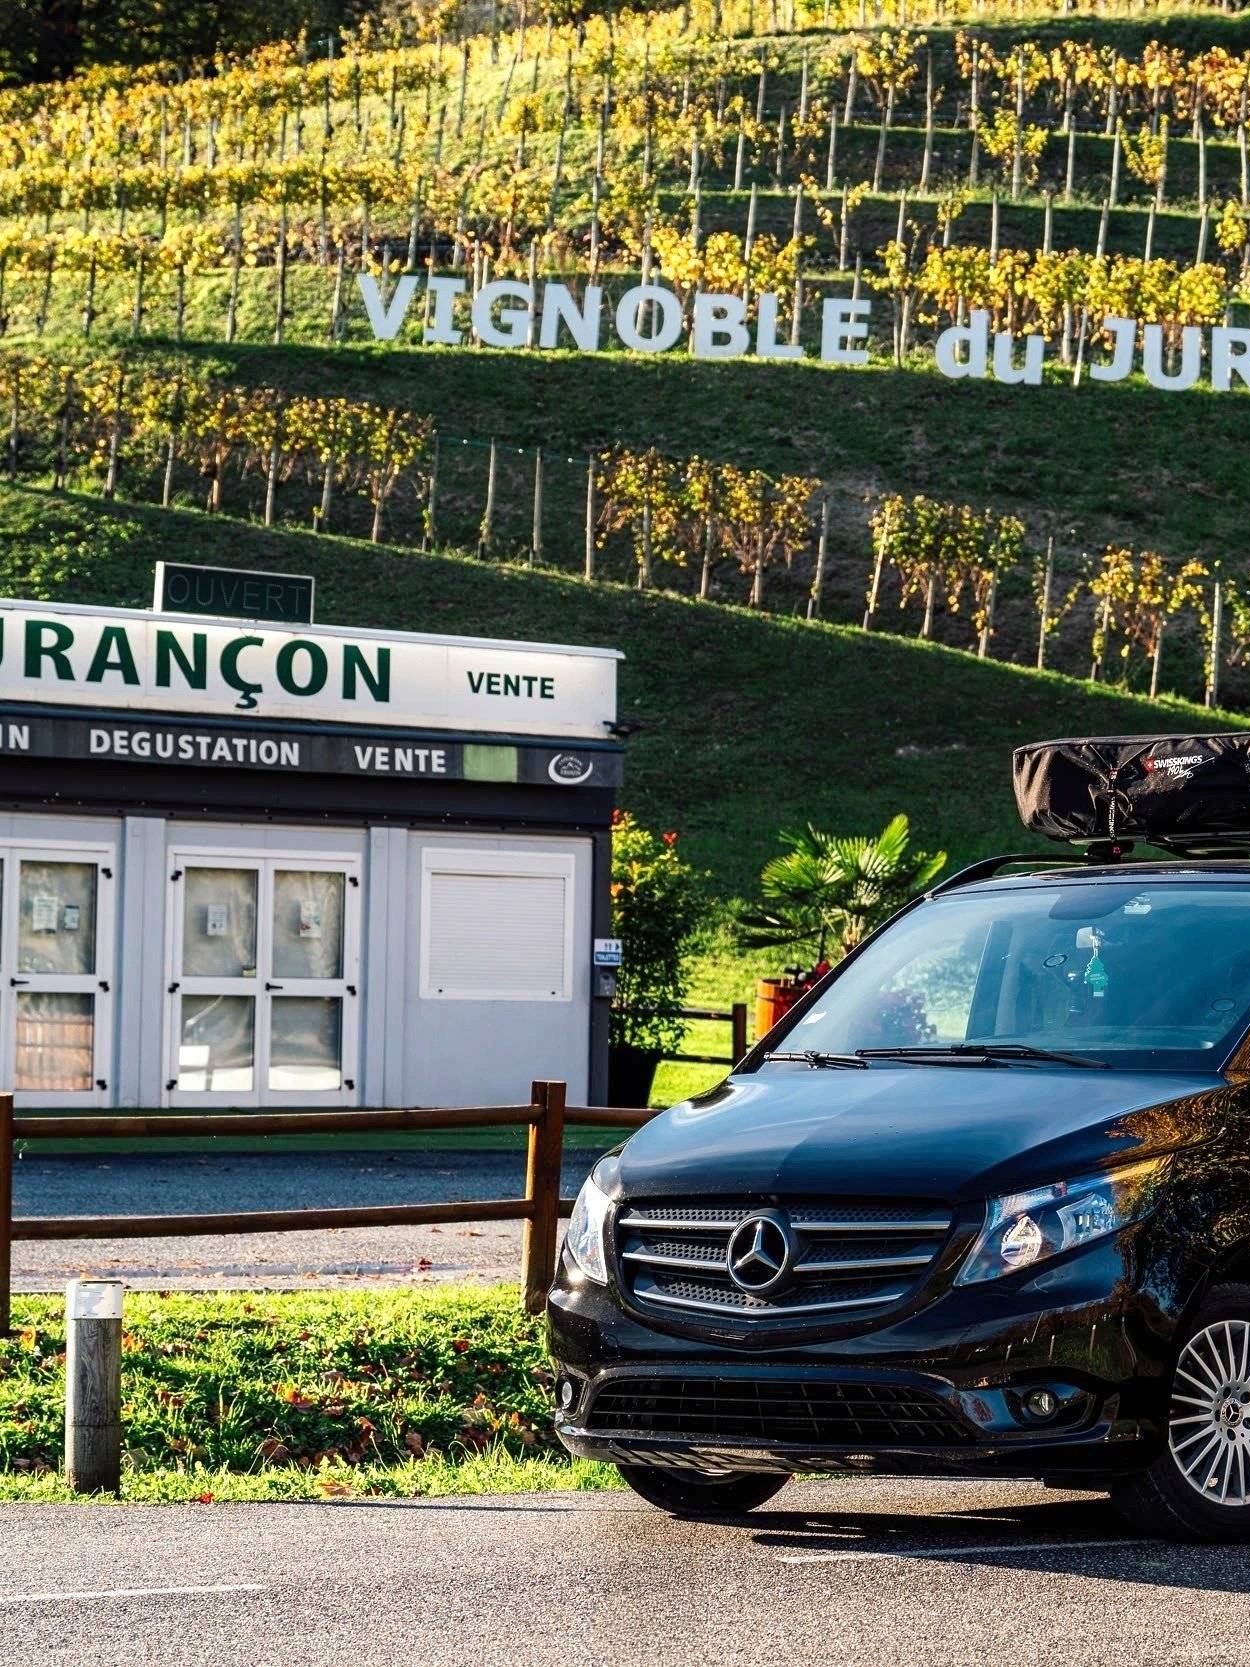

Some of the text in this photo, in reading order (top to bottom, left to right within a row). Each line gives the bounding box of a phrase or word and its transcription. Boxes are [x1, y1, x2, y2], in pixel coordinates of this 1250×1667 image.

[357, 275, 871, 364] VIGNOBLE
[935, 310, 1044, 384] du
[168, 574, 306, 615] OUVERT
[0, 618, 555, 709] RANÇON VENTE
[90, 729, 300, 767] DEGUSTATION
[354, 745, 446, 774] VENTE
[1153, 755, 1203, 769] SWISSKINGS
